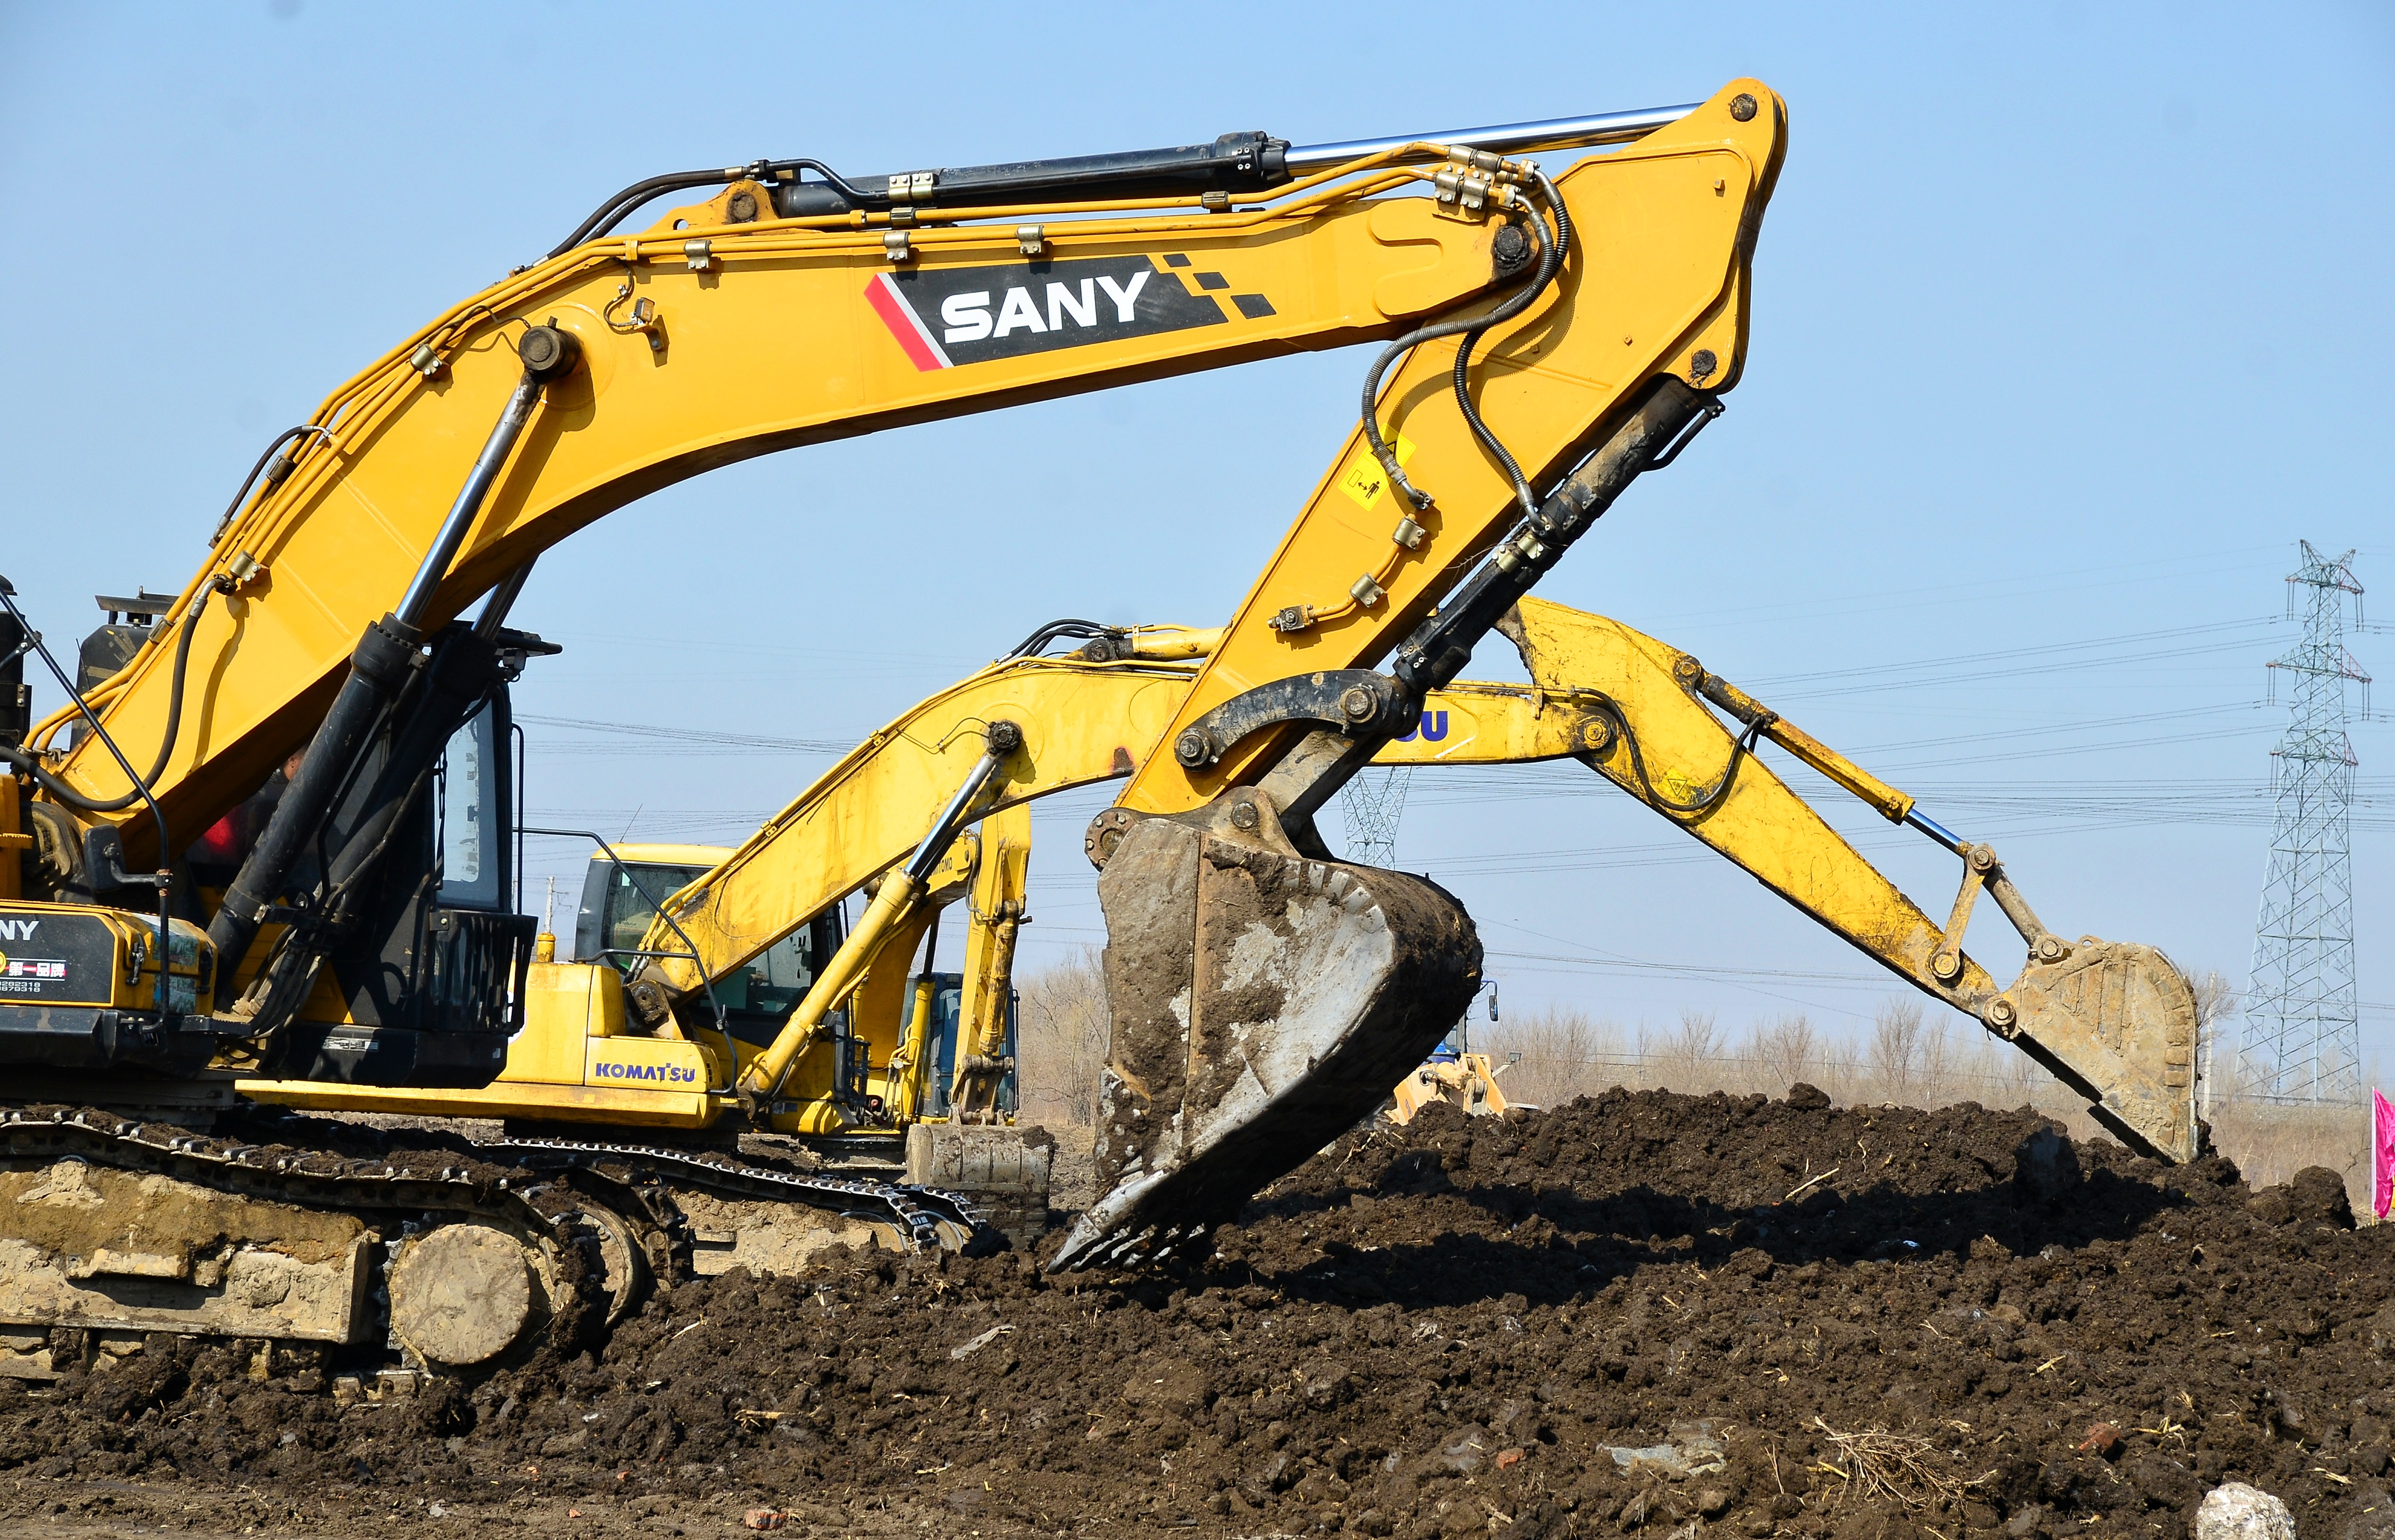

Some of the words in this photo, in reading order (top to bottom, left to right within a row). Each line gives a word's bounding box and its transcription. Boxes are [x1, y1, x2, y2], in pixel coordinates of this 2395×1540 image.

[941, 271, 1151, 344] SANY
[1394, 711, 1448, 742] U
[9, 962, 65, 977] 第一品牌
[596, 1063, 695, 1082] KOMATSU
